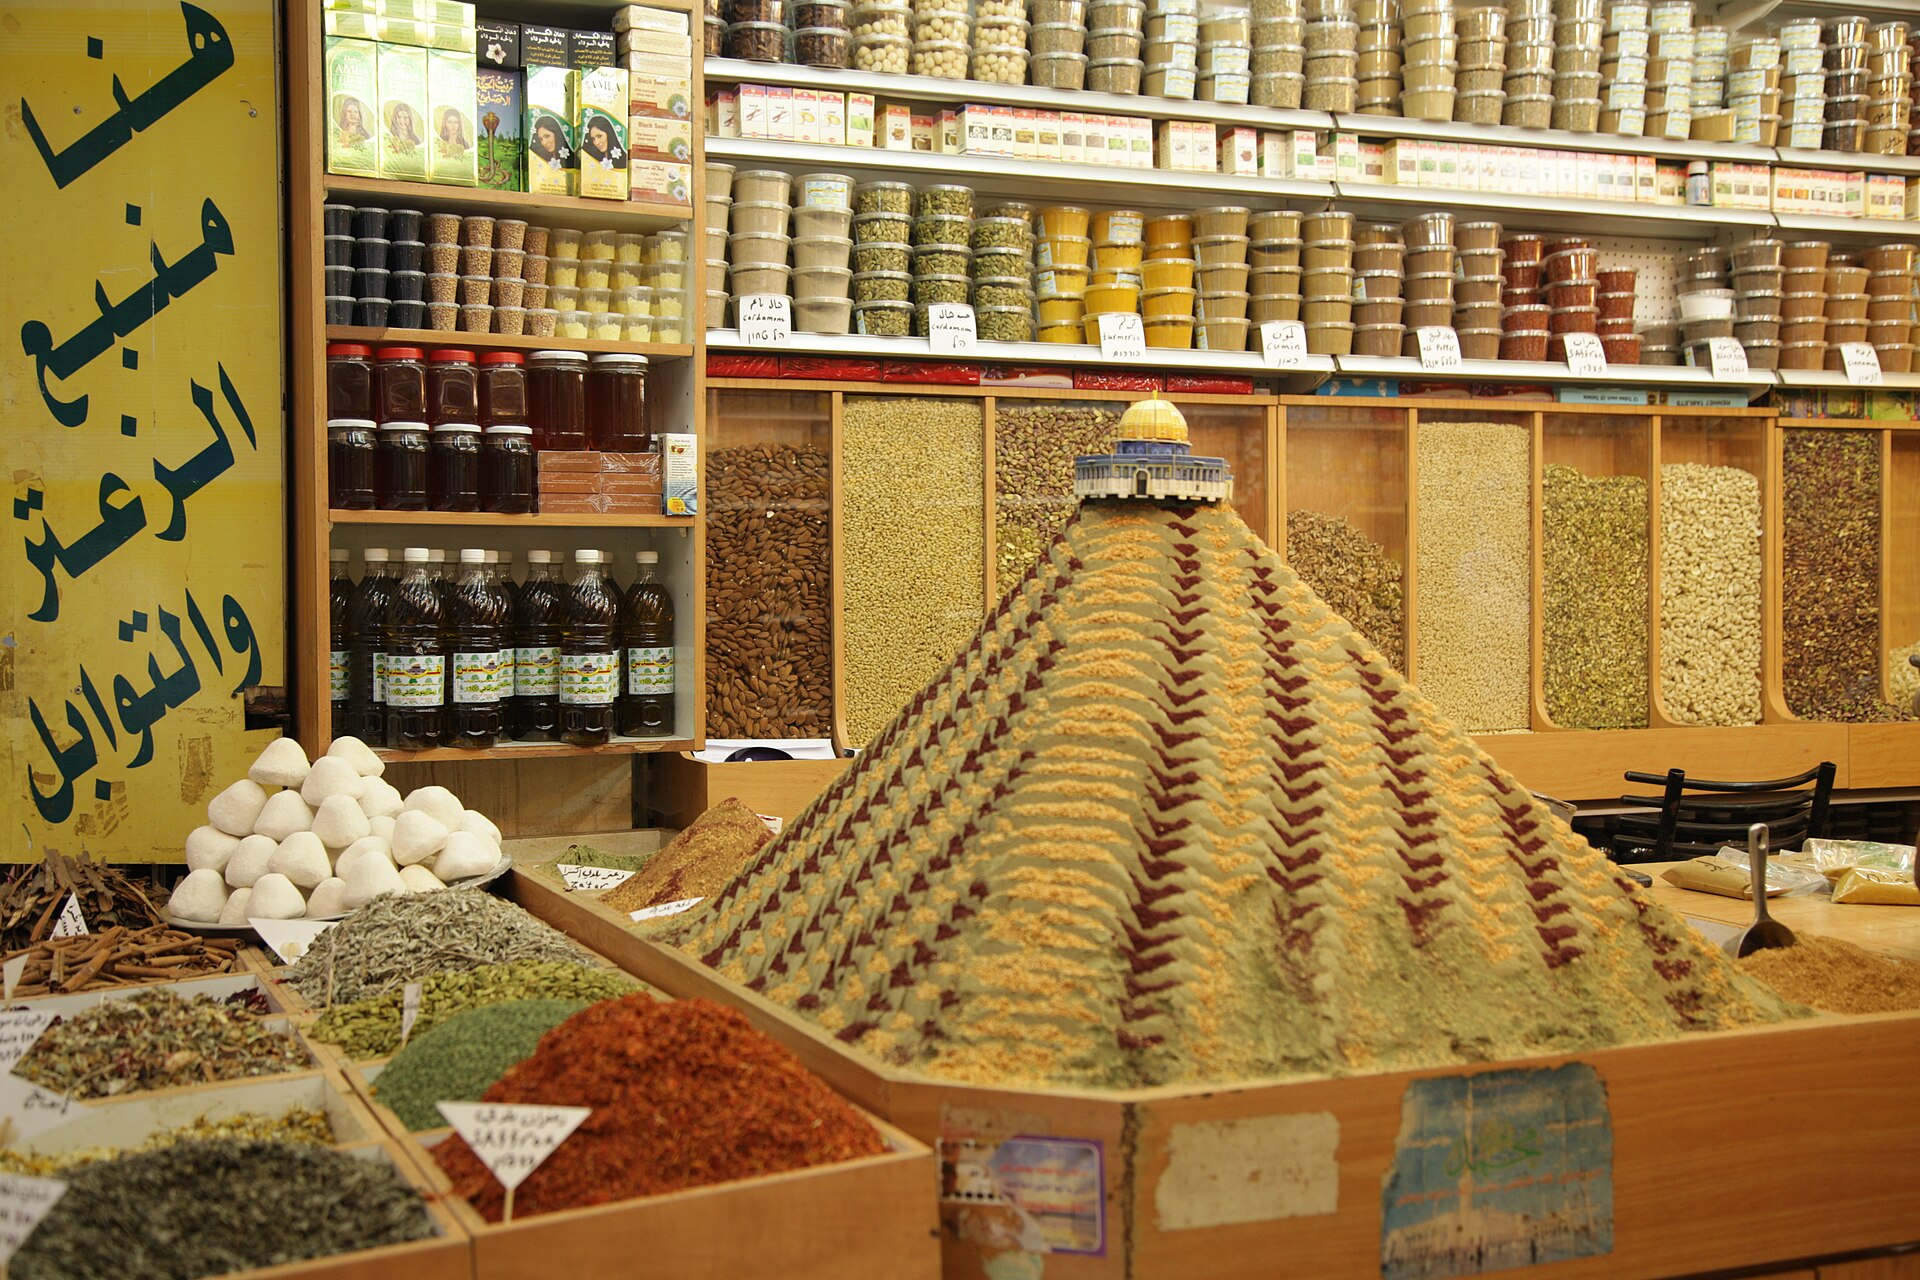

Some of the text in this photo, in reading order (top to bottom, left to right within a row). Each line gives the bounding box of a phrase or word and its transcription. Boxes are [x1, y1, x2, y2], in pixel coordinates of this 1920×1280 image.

[21, 1, 234, 190] هنا
[21, 197, 234, 428] منبع
[742, 313, 785, 323] cardamom
[1102, 332, 1141, 341] turmeric
[13, 360, 258, 623] الزعتر
[25, 588, 262, 824] والتوابل
